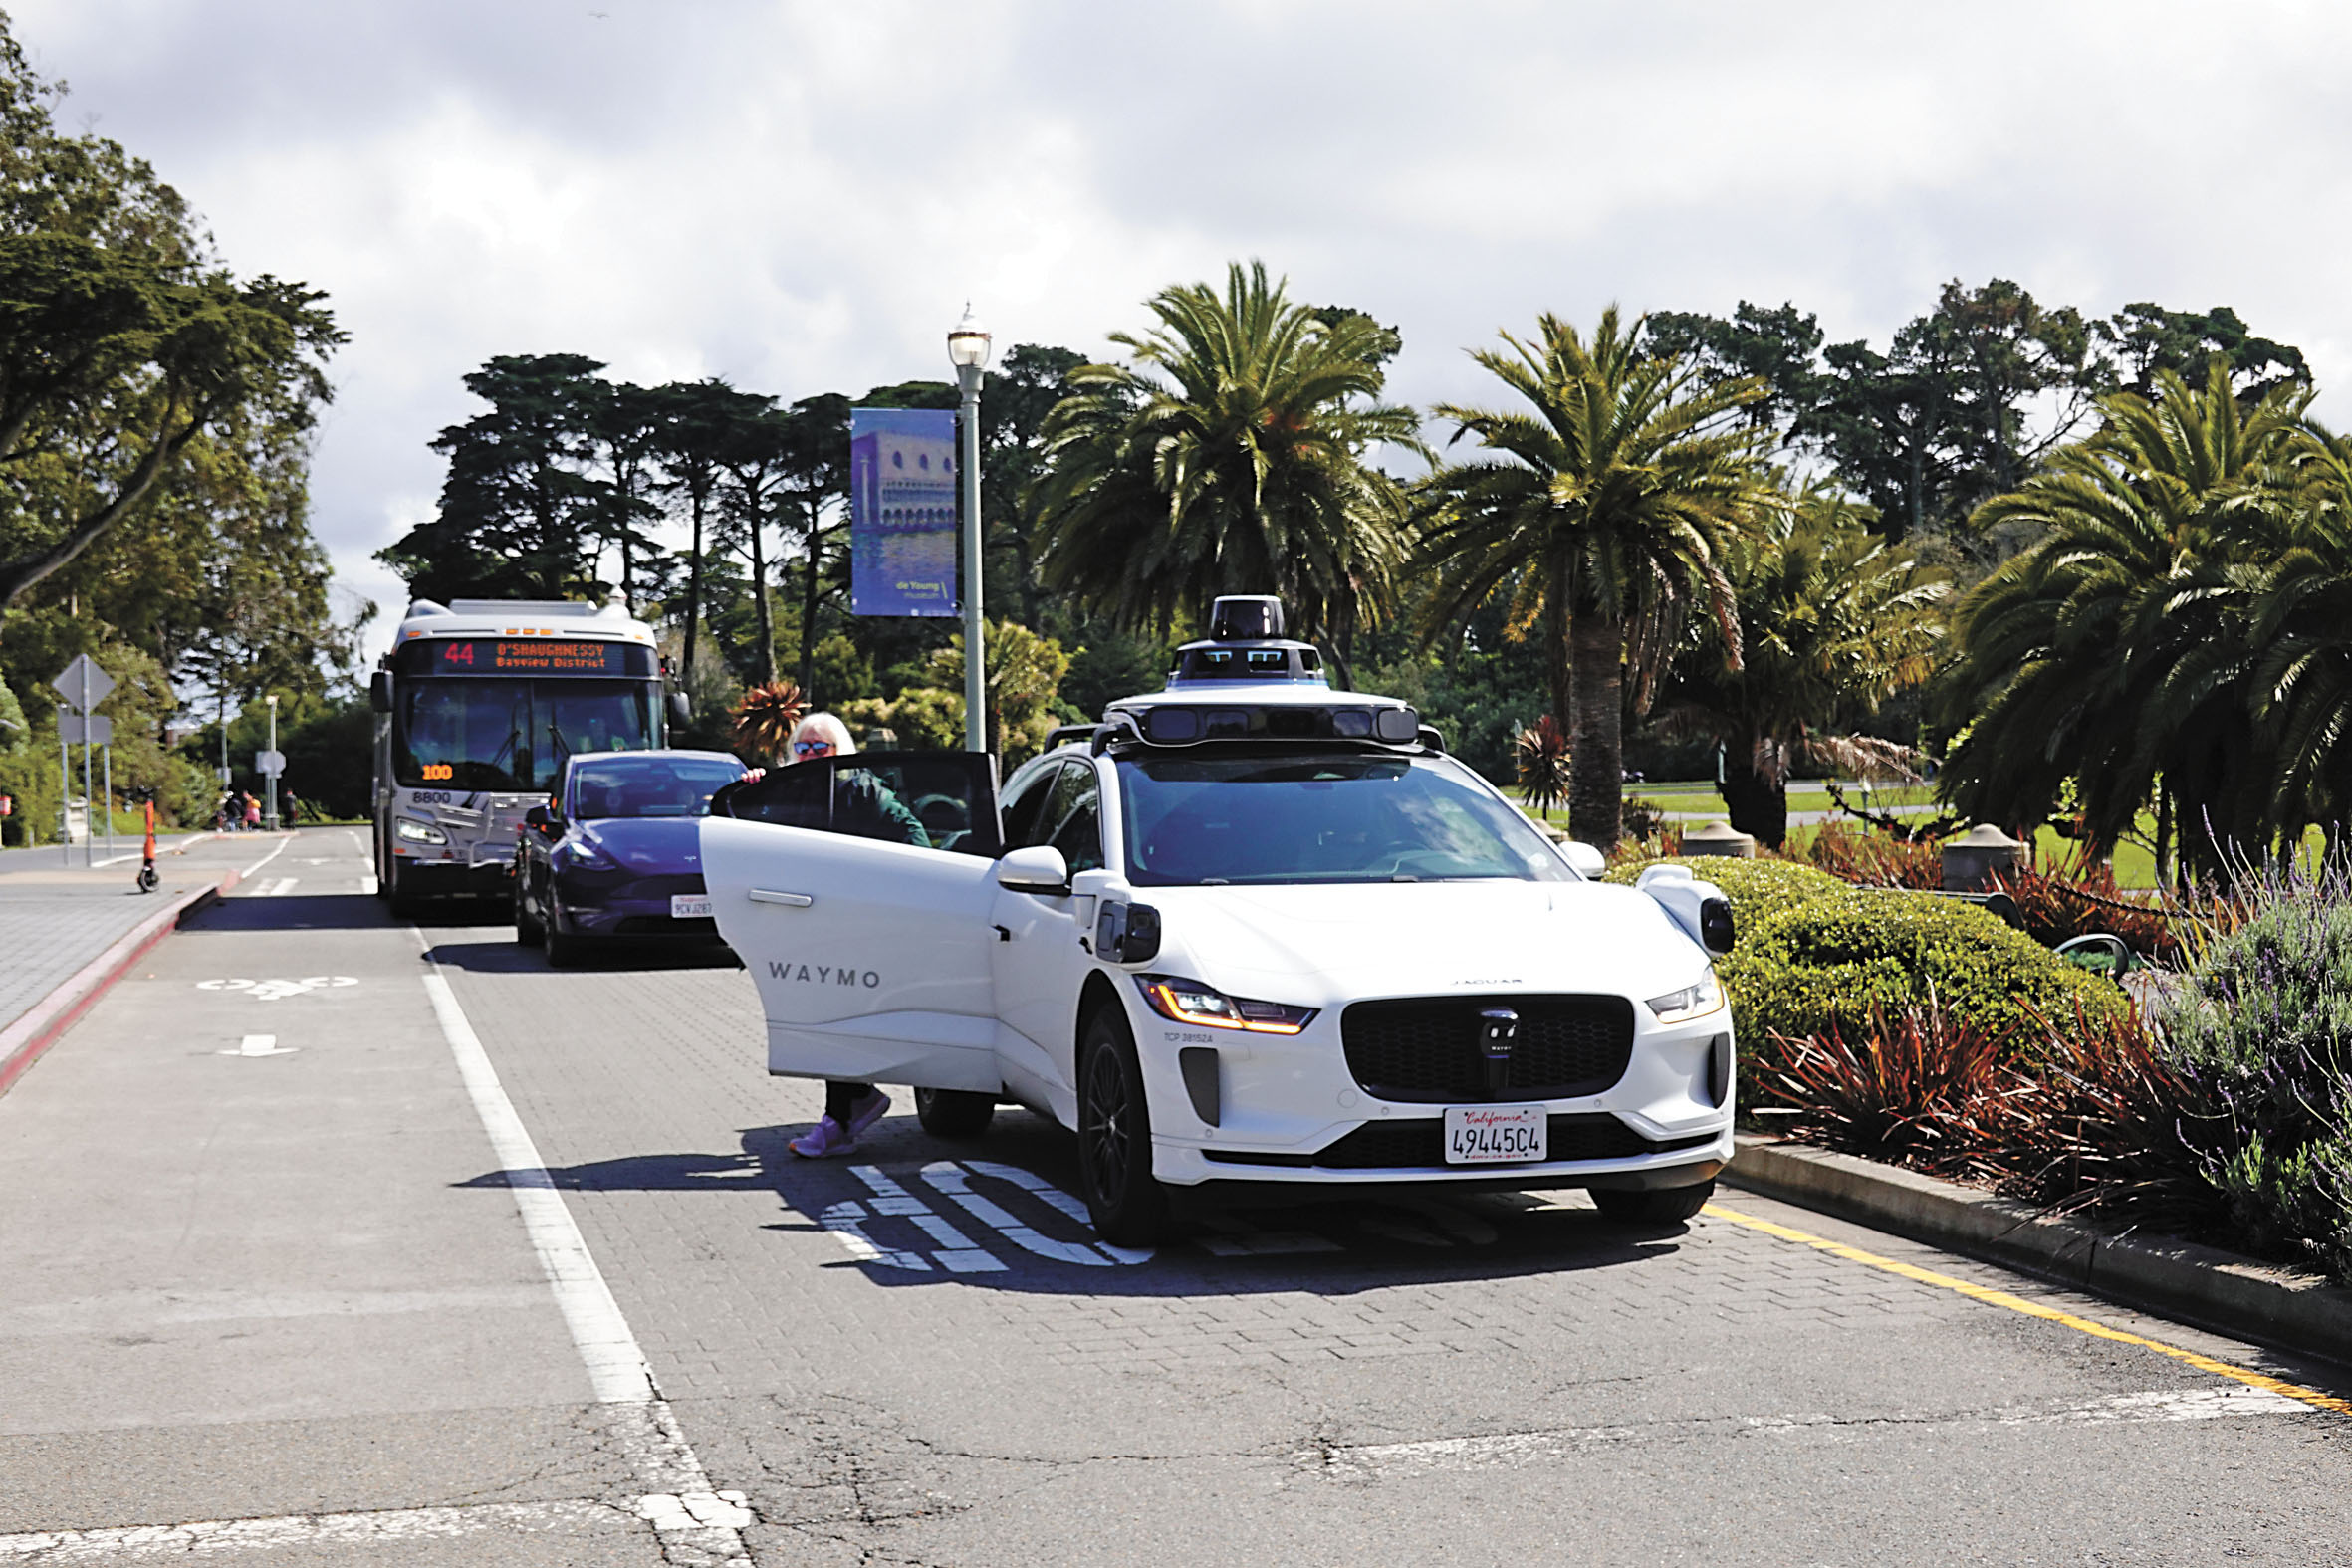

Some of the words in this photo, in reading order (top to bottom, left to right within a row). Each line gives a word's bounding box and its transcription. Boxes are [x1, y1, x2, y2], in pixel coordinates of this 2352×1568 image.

[444, 642, 474, 665] 44
[496, 657, 549, 667] Bayview
[554, 657, 605, 668] District
[422, 764, 453, 780] 100
[413, 791, 451, 804] 8800
[769, 961, 880, 989] WAYMO
[1164, 1032, 1180, 1042] TCP
[1466, 1111, 1528, 1127] California
[1453, 1127, 1539, 1154] 49445C4
